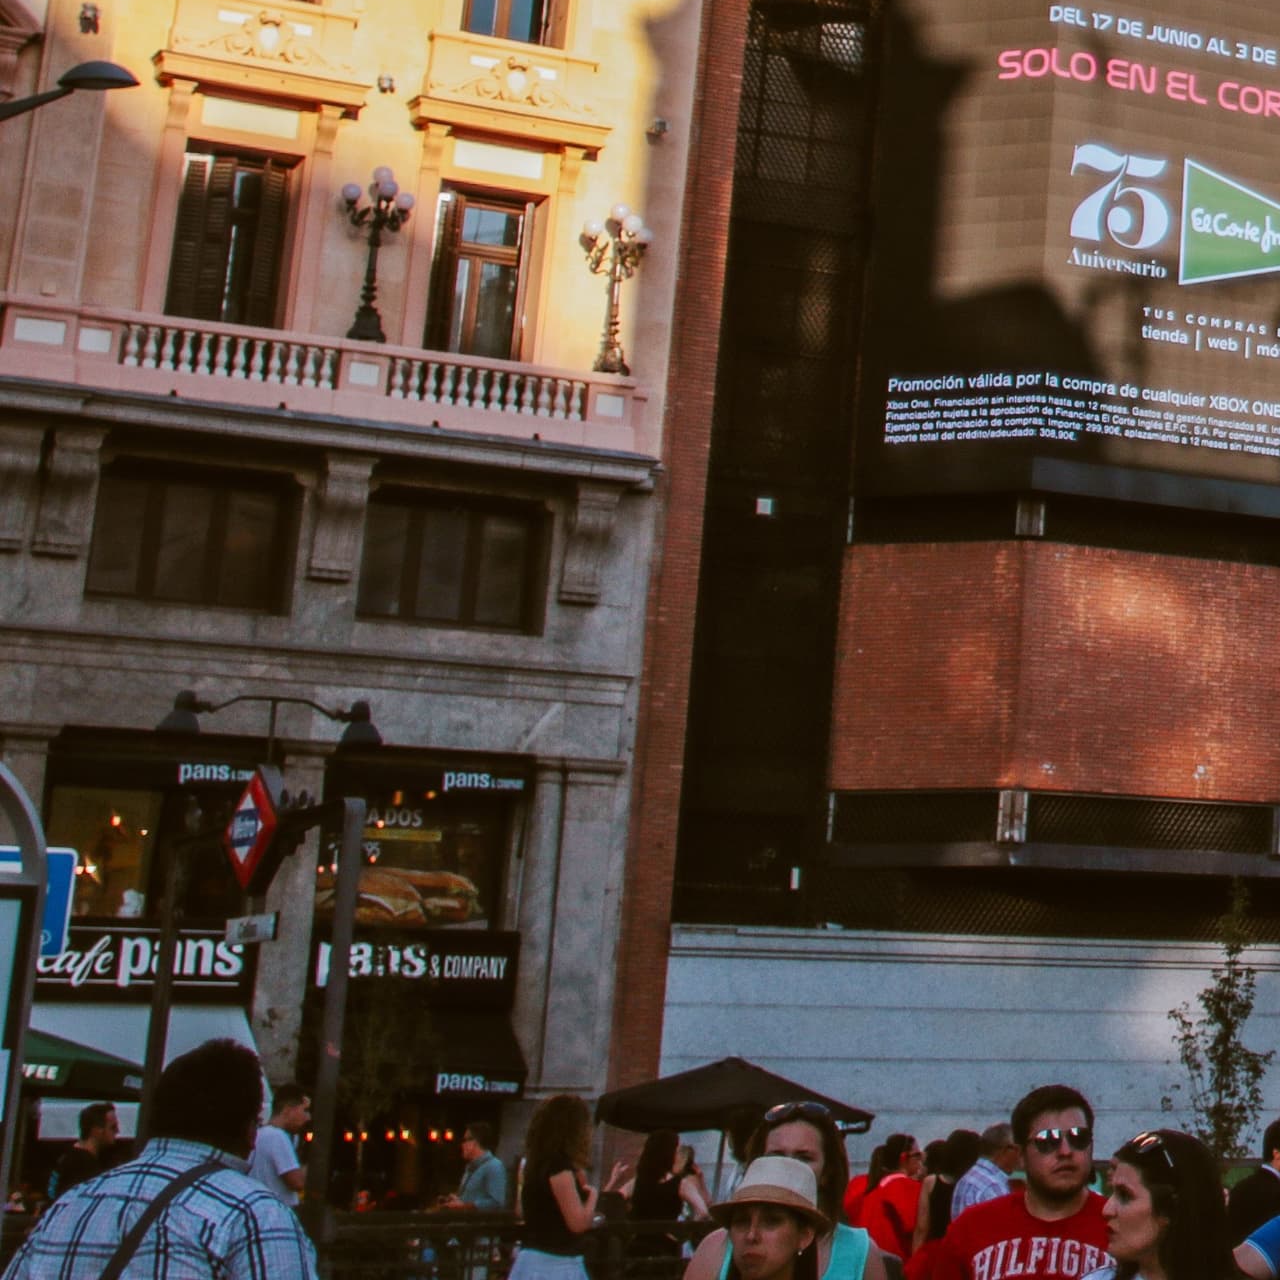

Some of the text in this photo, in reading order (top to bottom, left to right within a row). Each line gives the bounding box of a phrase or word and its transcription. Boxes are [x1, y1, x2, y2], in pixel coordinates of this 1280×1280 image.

[1049, 5, 1087, 27] DEL
[1092, 12, 1113, 31] 17
[1117, 18, 1143, 38] DE
[1146, 24, 1202, 50] JUNIO
[1207, 37, 1231, 57] AL
[1235, 42, 1248, 60] 3
[1252, 45, 1276, 65] DE
[998, 47, 1097, 82] SOLO
[1106, 59, 1157, 95] EN
[1167, 72, 1207, 105] EL
[1070, 143, 1171, 250] 75
[1066, 246, 1169, 280] Aniversario
[1143, 306, 1175, 322] TUS
[1185, 313, 1268, 335] COMPRAS
[1141, 324, 1188, 345] tienda
[1207, 334, 1239, 352] web
[888, 375, 964, 392] Promoción
[968, 373, 1012, 388] válida
[1016, 372, 1042, 389] por
[1045, 372, 1058, 388] la
[1062, 377, 1116, 396] compra
[1120, 383, 1138, 399] de
[1142, 388, 1206, 407] cualquier
[1209, 395, 1249, 414] XBOX
[178, 764, 230, 784] pans
[442, 771, 491, 792] pans
[430, 954, 441, 978] &
[443, 955, 508, 980] COMPANY
[435, 1072, 485, 1094] pans
